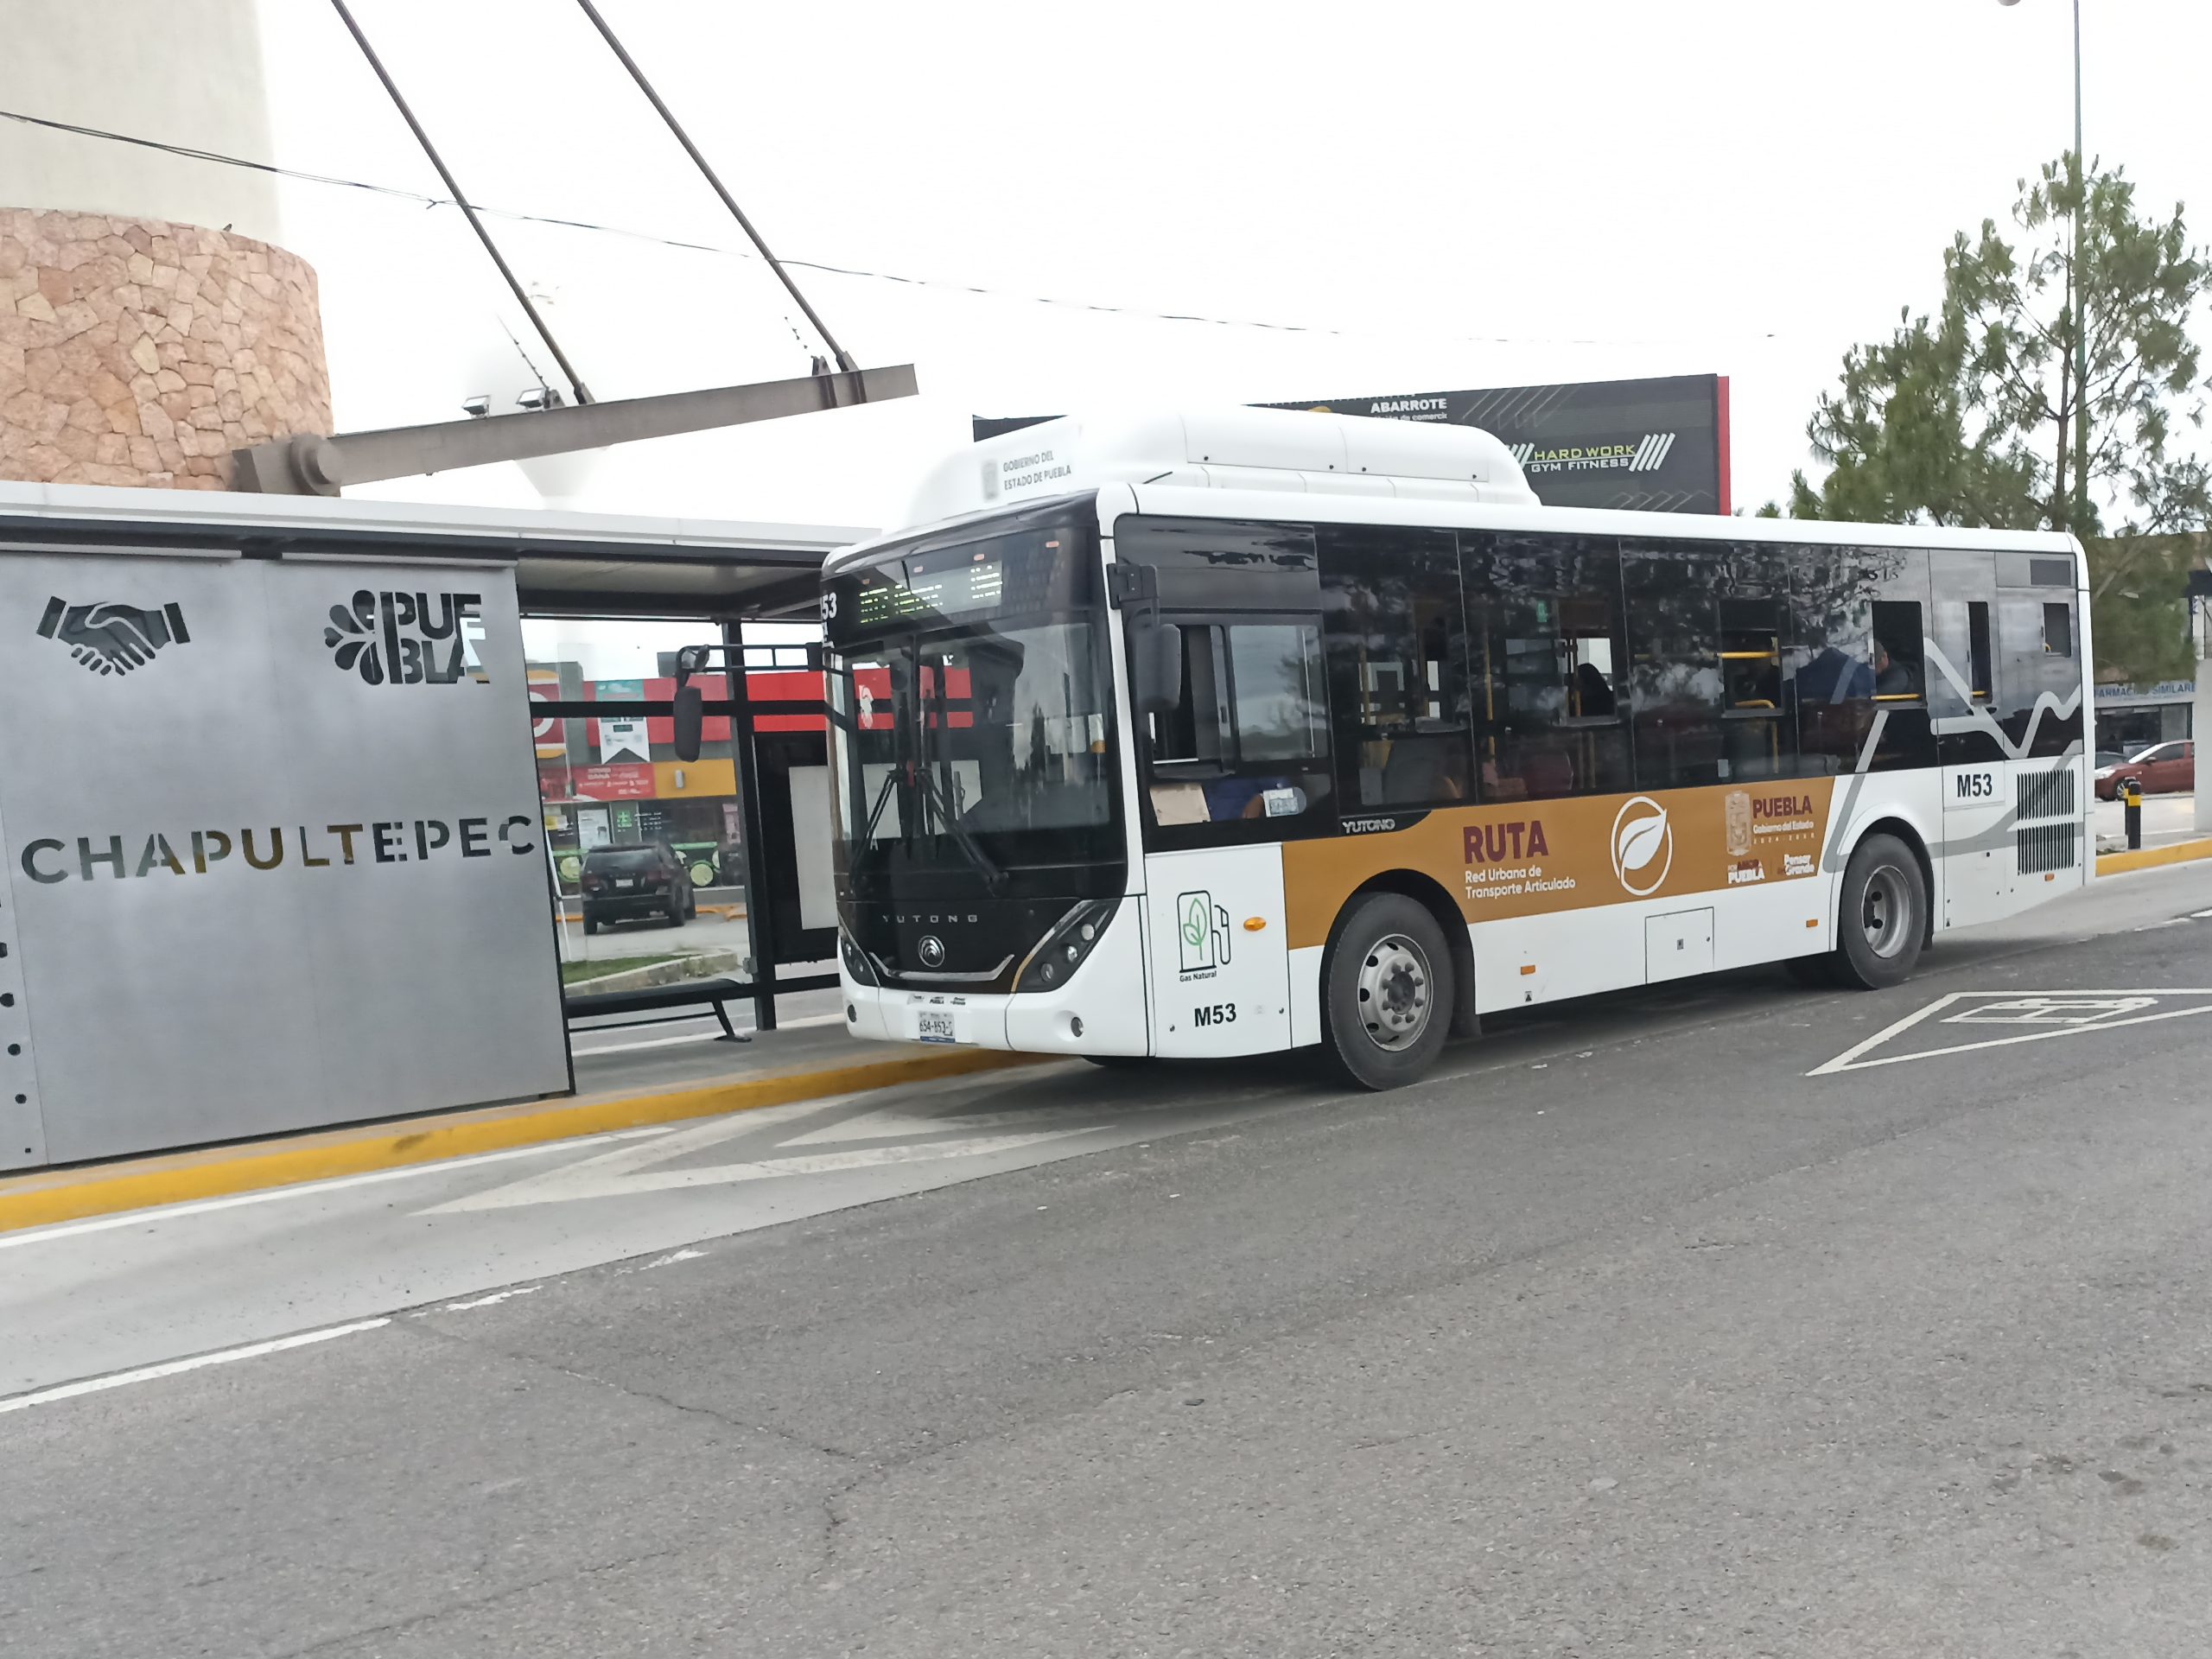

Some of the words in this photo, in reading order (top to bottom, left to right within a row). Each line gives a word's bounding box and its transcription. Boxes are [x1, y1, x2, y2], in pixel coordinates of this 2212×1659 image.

[1370, 398, 1447, 413] ABARROTE
[1003, 454, 1040, 473] GOBIERNO
[1041, 450, 1054, 463] DEL
[1534, 448, 1582, 461] HARD
[1586, 444, 1636, 458] WORK
[1531, 462, 1561, 473] GYM
[1567, 458, 1629, 470] FITNESS
[1004, 474, 1032, 490] ESTADO
[1033, 471, 1042, 483] DE
[1044, 465, 1071, 480] PUEBLA
[1957, 773, 1993, 798] M53
[1752, 795, 1813, 819] PUEBLA
[1342, 818, 1396, 835] YUTONG
[21, 815, 535, 884] CHAPULTEPEC
[1463, 820, 1548, 864] RUTA
[1465, 869, 1486, 883] Red
[1488, 867, 1527, 881] Urbana
[1528, 864, 1542, 878] de
[1465, 882, 1522, 899] Transporte
[1524, 876, 1576, 893] Articulado
[882, 914, 978, 924] YUTONG
[1193, 969, 1217, 981] Natural
[1194, 1002, 1237, 1027] M53
